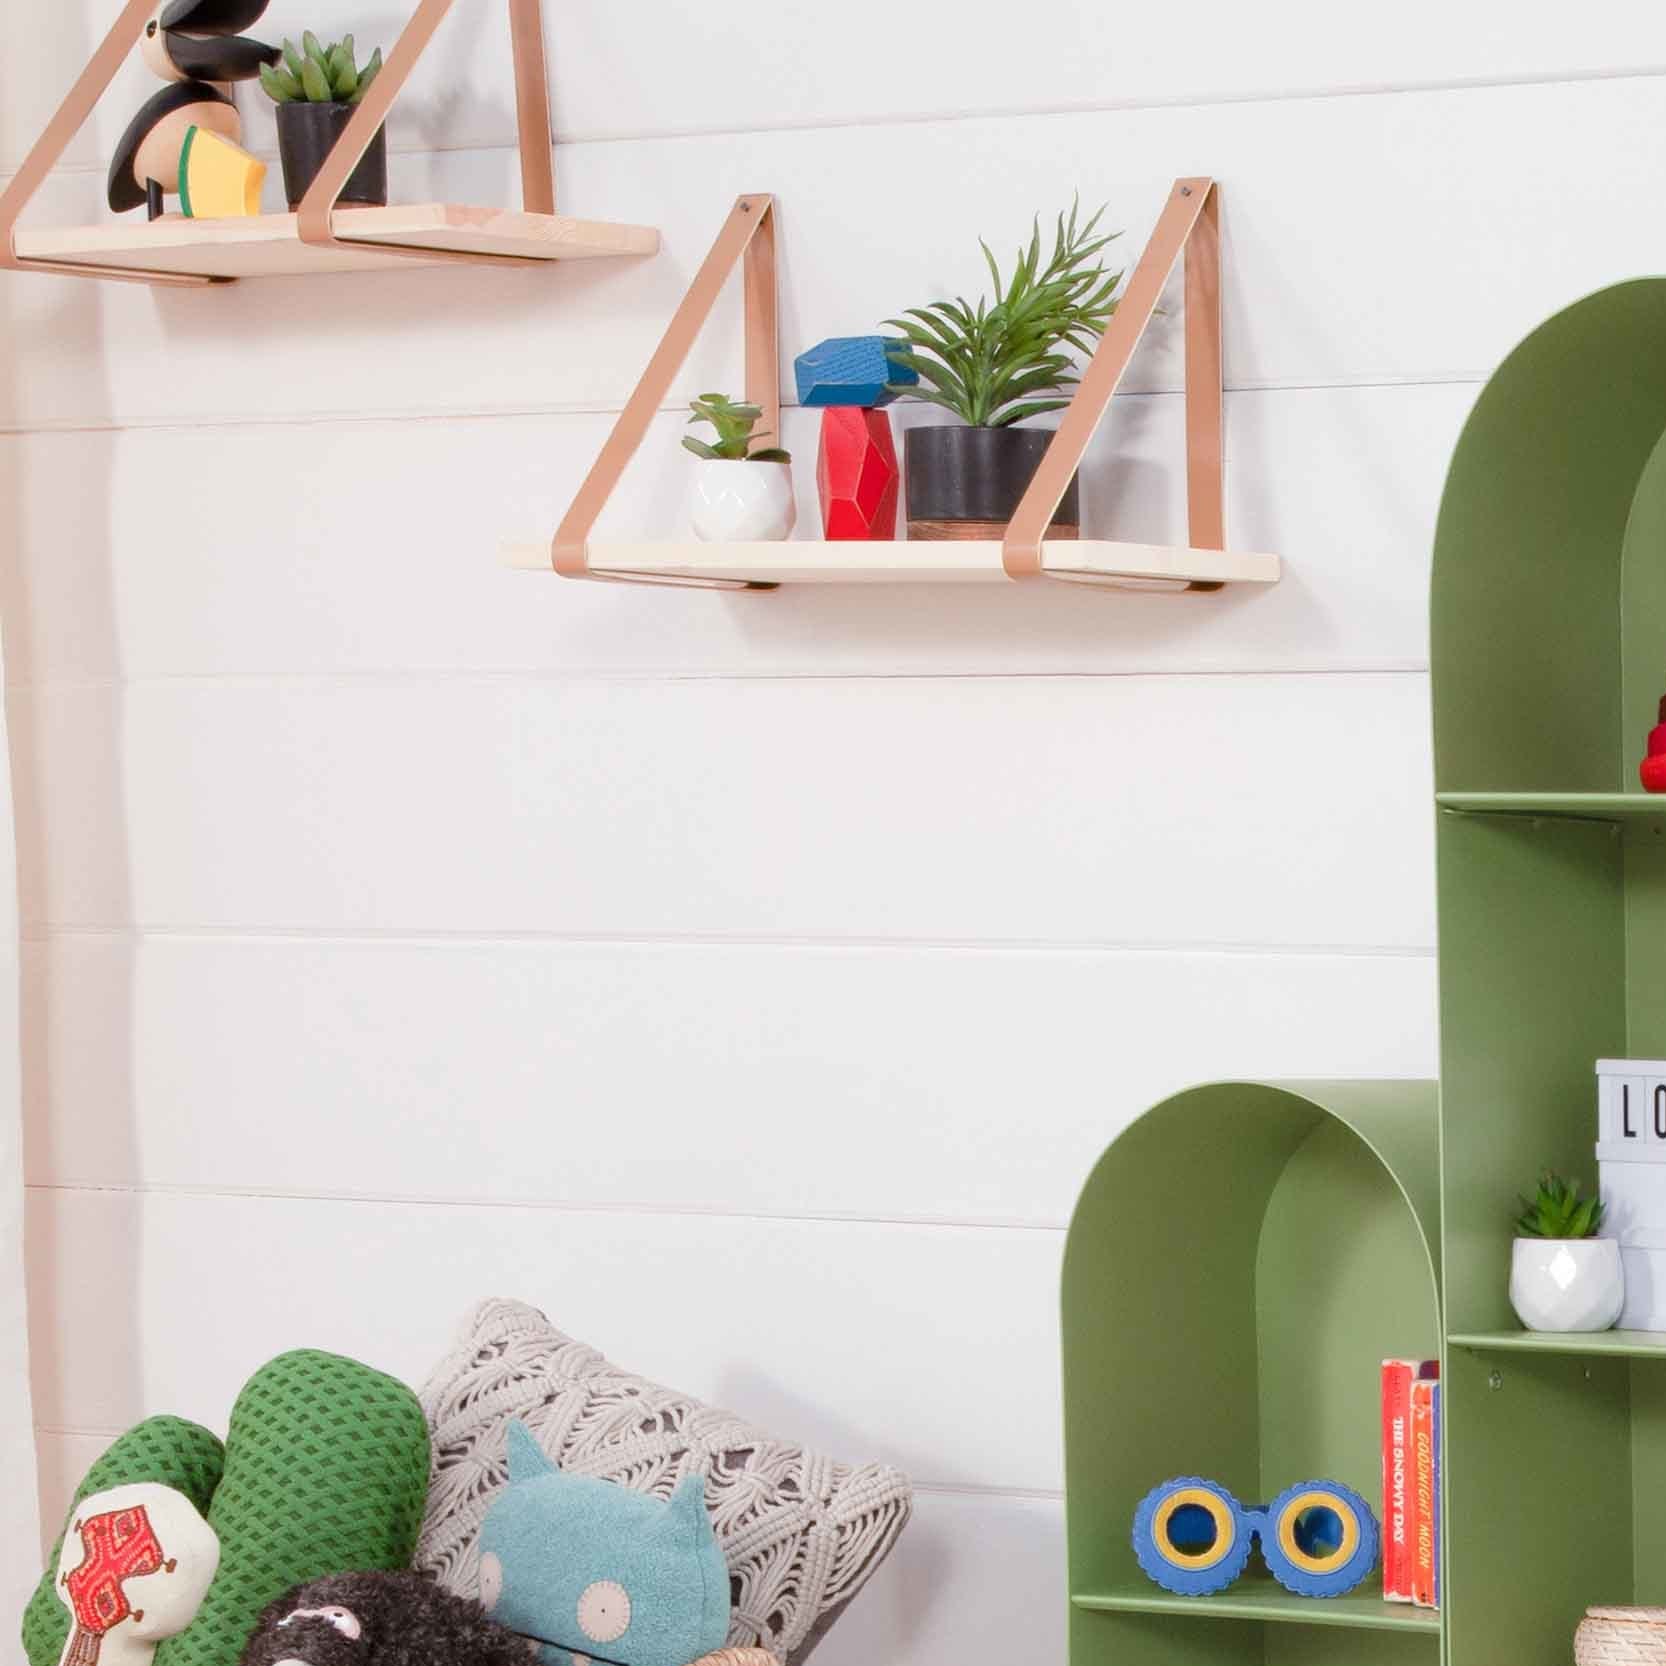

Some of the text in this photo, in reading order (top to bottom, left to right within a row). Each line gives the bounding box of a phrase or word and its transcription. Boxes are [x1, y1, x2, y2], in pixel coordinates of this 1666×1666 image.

[1393, 1416, 1404, 1446] THE
[1393, 1447, 1404, 1508] SNOWY
[1417, 1432, 1431, 1569] GOODNIGHT MOON
[1393, 1511, 1405, 1544] DAY
